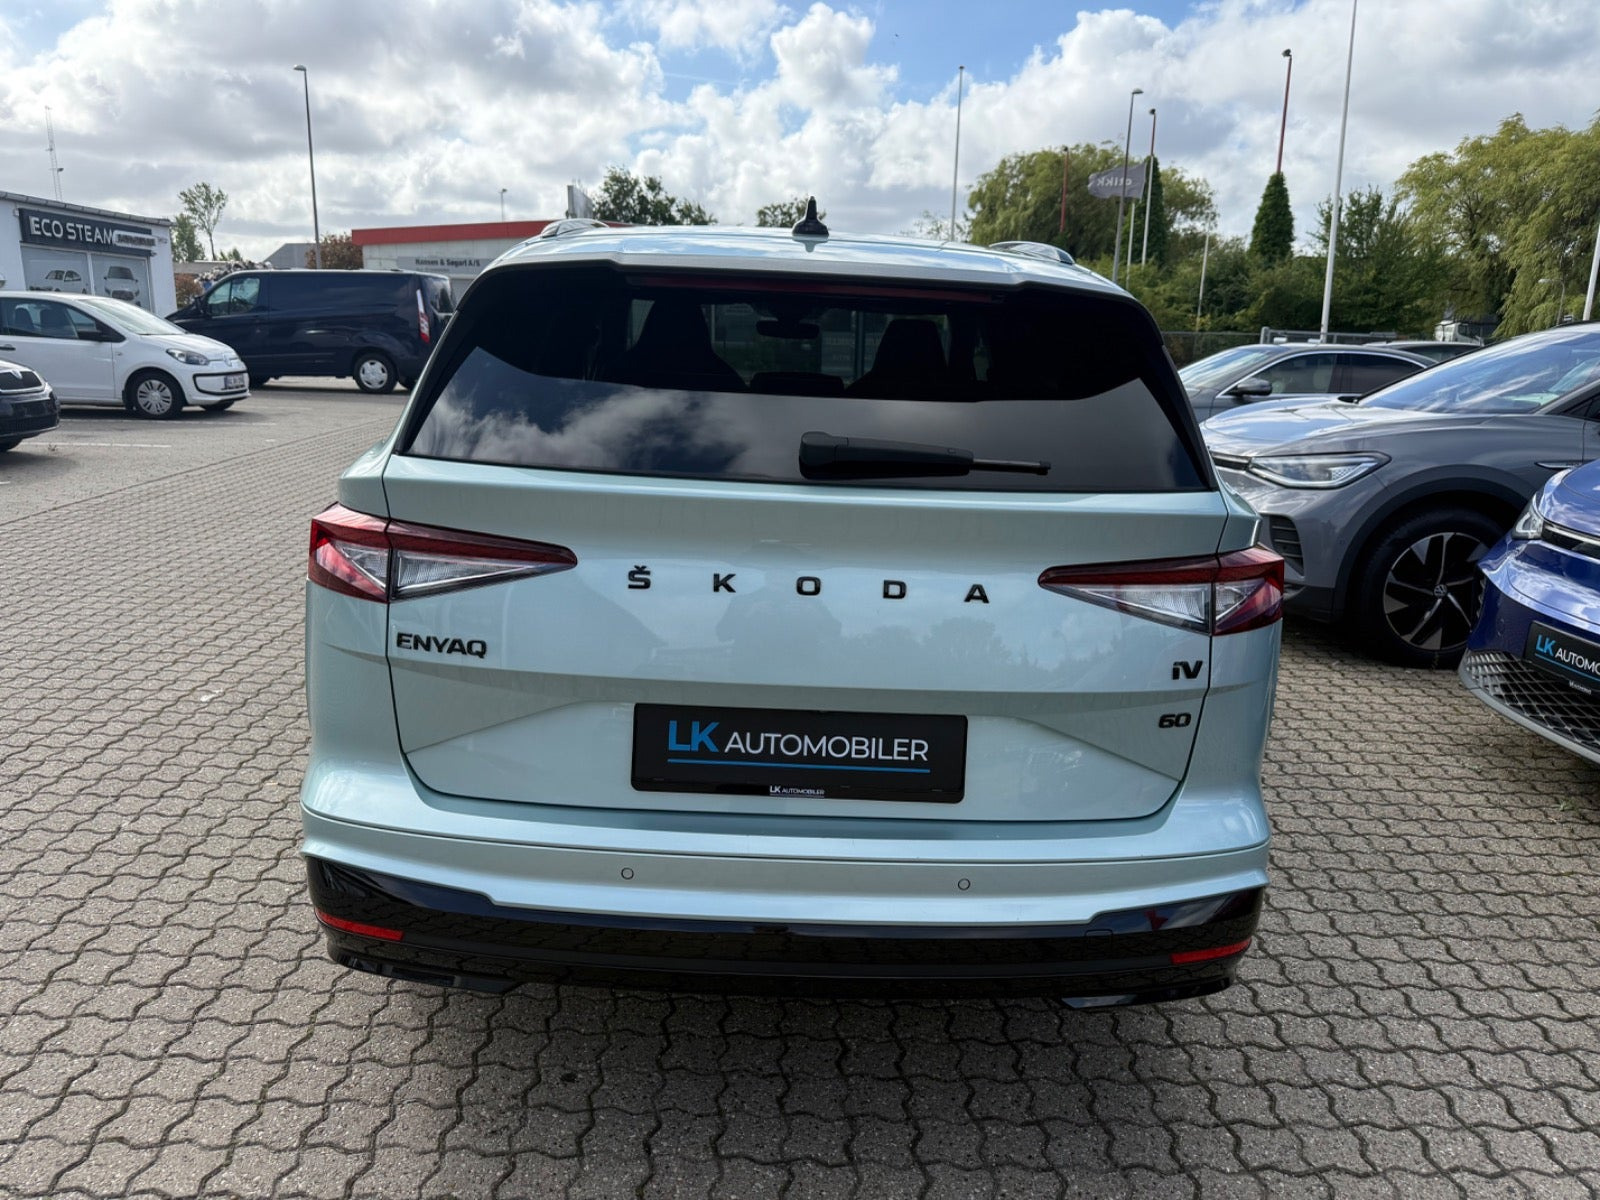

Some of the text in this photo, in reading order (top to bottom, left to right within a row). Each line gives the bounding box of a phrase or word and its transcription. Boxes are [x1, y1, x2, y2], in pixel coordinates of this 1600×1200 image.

[29, 215, 64, 239] ECO
[65, 222, 114, 245] STEAM
[396, 631, 488, 659] ENYAQ
[1535, 634, 1557, 657] LK
[1158, 712, 1192, 729] 60
[668, 720, 929, 762] LK AUTOMOBILER
[769, 785, 825, 795] LK AUTOMOBILER
